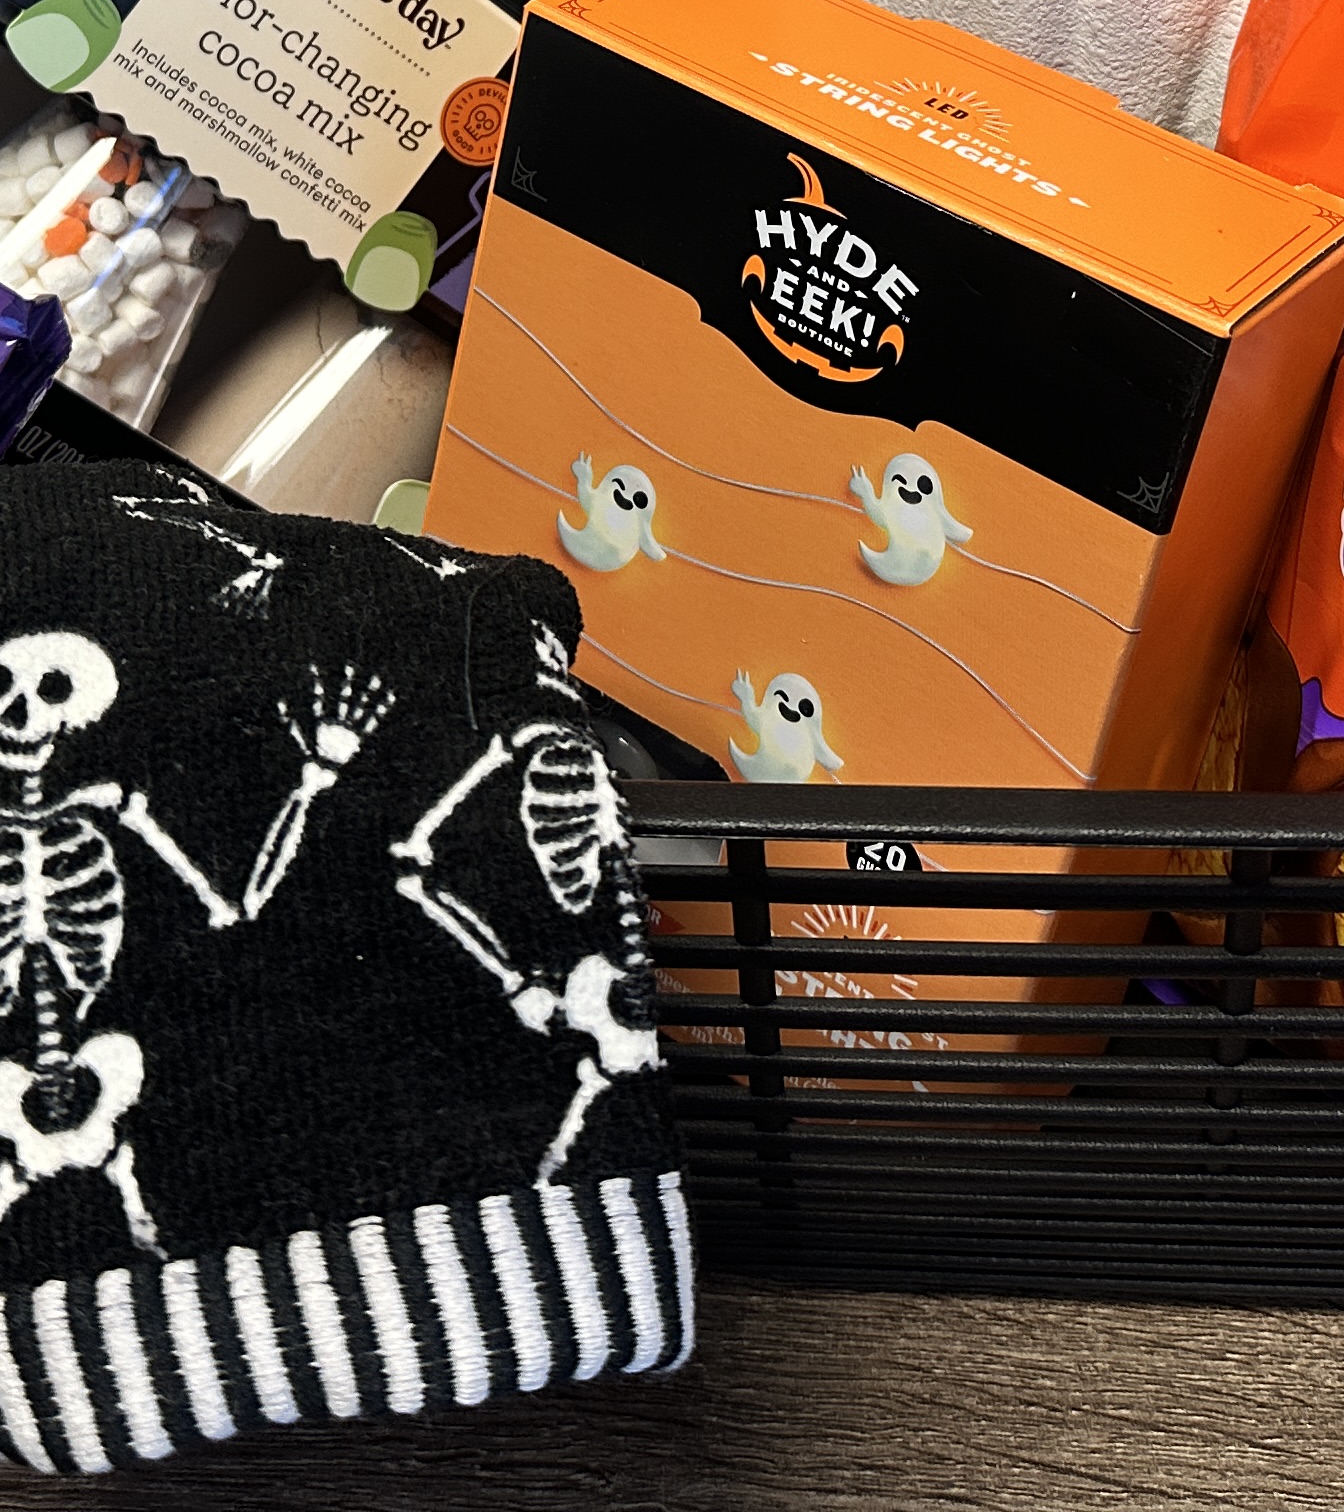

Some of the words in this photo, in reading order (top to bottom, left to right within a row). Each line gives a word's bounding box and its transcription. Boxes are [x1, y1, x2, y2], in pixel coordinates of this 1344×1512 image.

[131, 38, 198, 93] Includes
[199, 89, 248, 128] cocoa
[249, 123, 278, 153] mix,
[283, 144, 324, 180] white
[325, 176, 372, 214] cocoa
[198, 30, 296, 110] cocoa
[296, 99, 365, 155] mix
[769, 61, 915, 131] STRING
[917, 129, 1063, 198] LIGHTS
[825, 73, 954, 132] IRIDESCENT
[956, 131, 1032, 166] GHOST
[923, 97, 969, 121] LED
[112, 52, 144, 79] mix
[144, 76, 180, 102] and
[178, 97, 280, 171] marshmallow
[280, 167, 343, 214] confetti
[338, 208, 368, 233] mix
[754, 209, 920, 316] HYDE
[770, 266, 876, 348] EEK!
[806, 265, 851, 293] AND
[777, 312, 854, 358] BOUTIQUE
[16, 425, 53, 459] OZ
